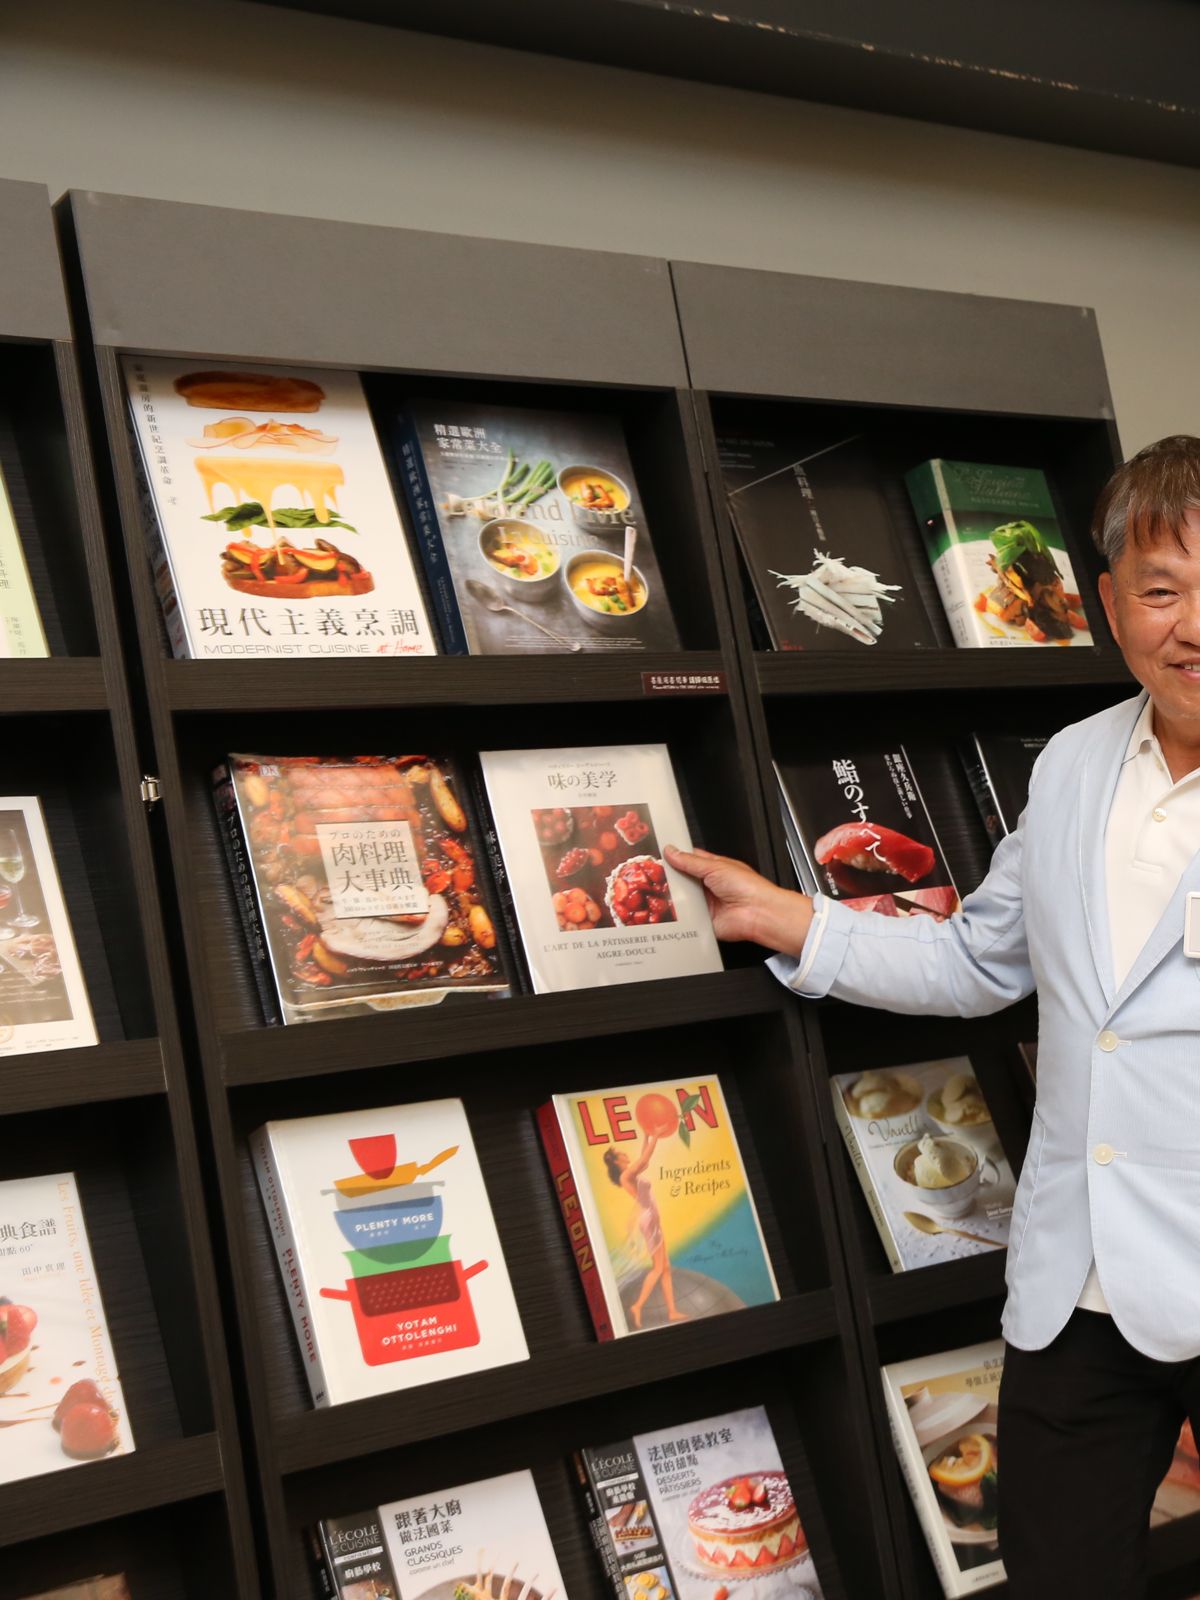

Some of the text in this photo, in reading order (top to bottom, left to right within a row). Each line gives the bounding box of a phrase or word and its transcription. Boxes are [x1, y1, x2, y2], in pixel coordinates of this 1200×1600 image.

[434, 424, 486, 439] 精選歐洲
[436, 438, 502, 453] 家常菜大全
[198, 607, 420, 637] 現代主義烹調
[204, 644, 302, 655] MODERNIST
[309, 644, 371, 654] CUISINE
[547, 770, 618, 790] 味の美学
[832, 758, 887, 863] 鮨のすべて
[329, 828, 401, 841] プロのための
[331, 841, 408, 867] 肉料理
[336, 867, 414, 894] 大事典
[544, 942, 569, 953] L'ART
[572, 940, 585, 950] DE
[587, 939, 600, 948] LA
[651, 931, 699, 944] FRANÇAISE
[577, 1085, 719, 1146] LEON
[659, 1159, 732, 1181] Ingredients
[670, 1179, 731, 1197] & Recipes
[355, 1212, 435, 1232] PLENTY MORE
[554, 1169, 593, 1272] LEON
[285, 1247, 317, 1363] PLENTY MORE
[396, 1316, 438, 1331] YOTAM
[381, 1324, 457, 1346] OTTOLENGHI
[648, 1427, 734, 1461] 法國廚藝教室
[652, 1455, 699, 1476] 教的甜點
[656, 1469, 696, 1486] DESSERTS
[395, 1498, 462, 1530] 跟著大廚
[399, 1519, 453, 1544] 做法國菜
[340, 1534, 382, 1553] CUISINE
[404, 1541, 443, 1557] GRANDS
[407, 1546, 463, 1567] CLASSIQUES
